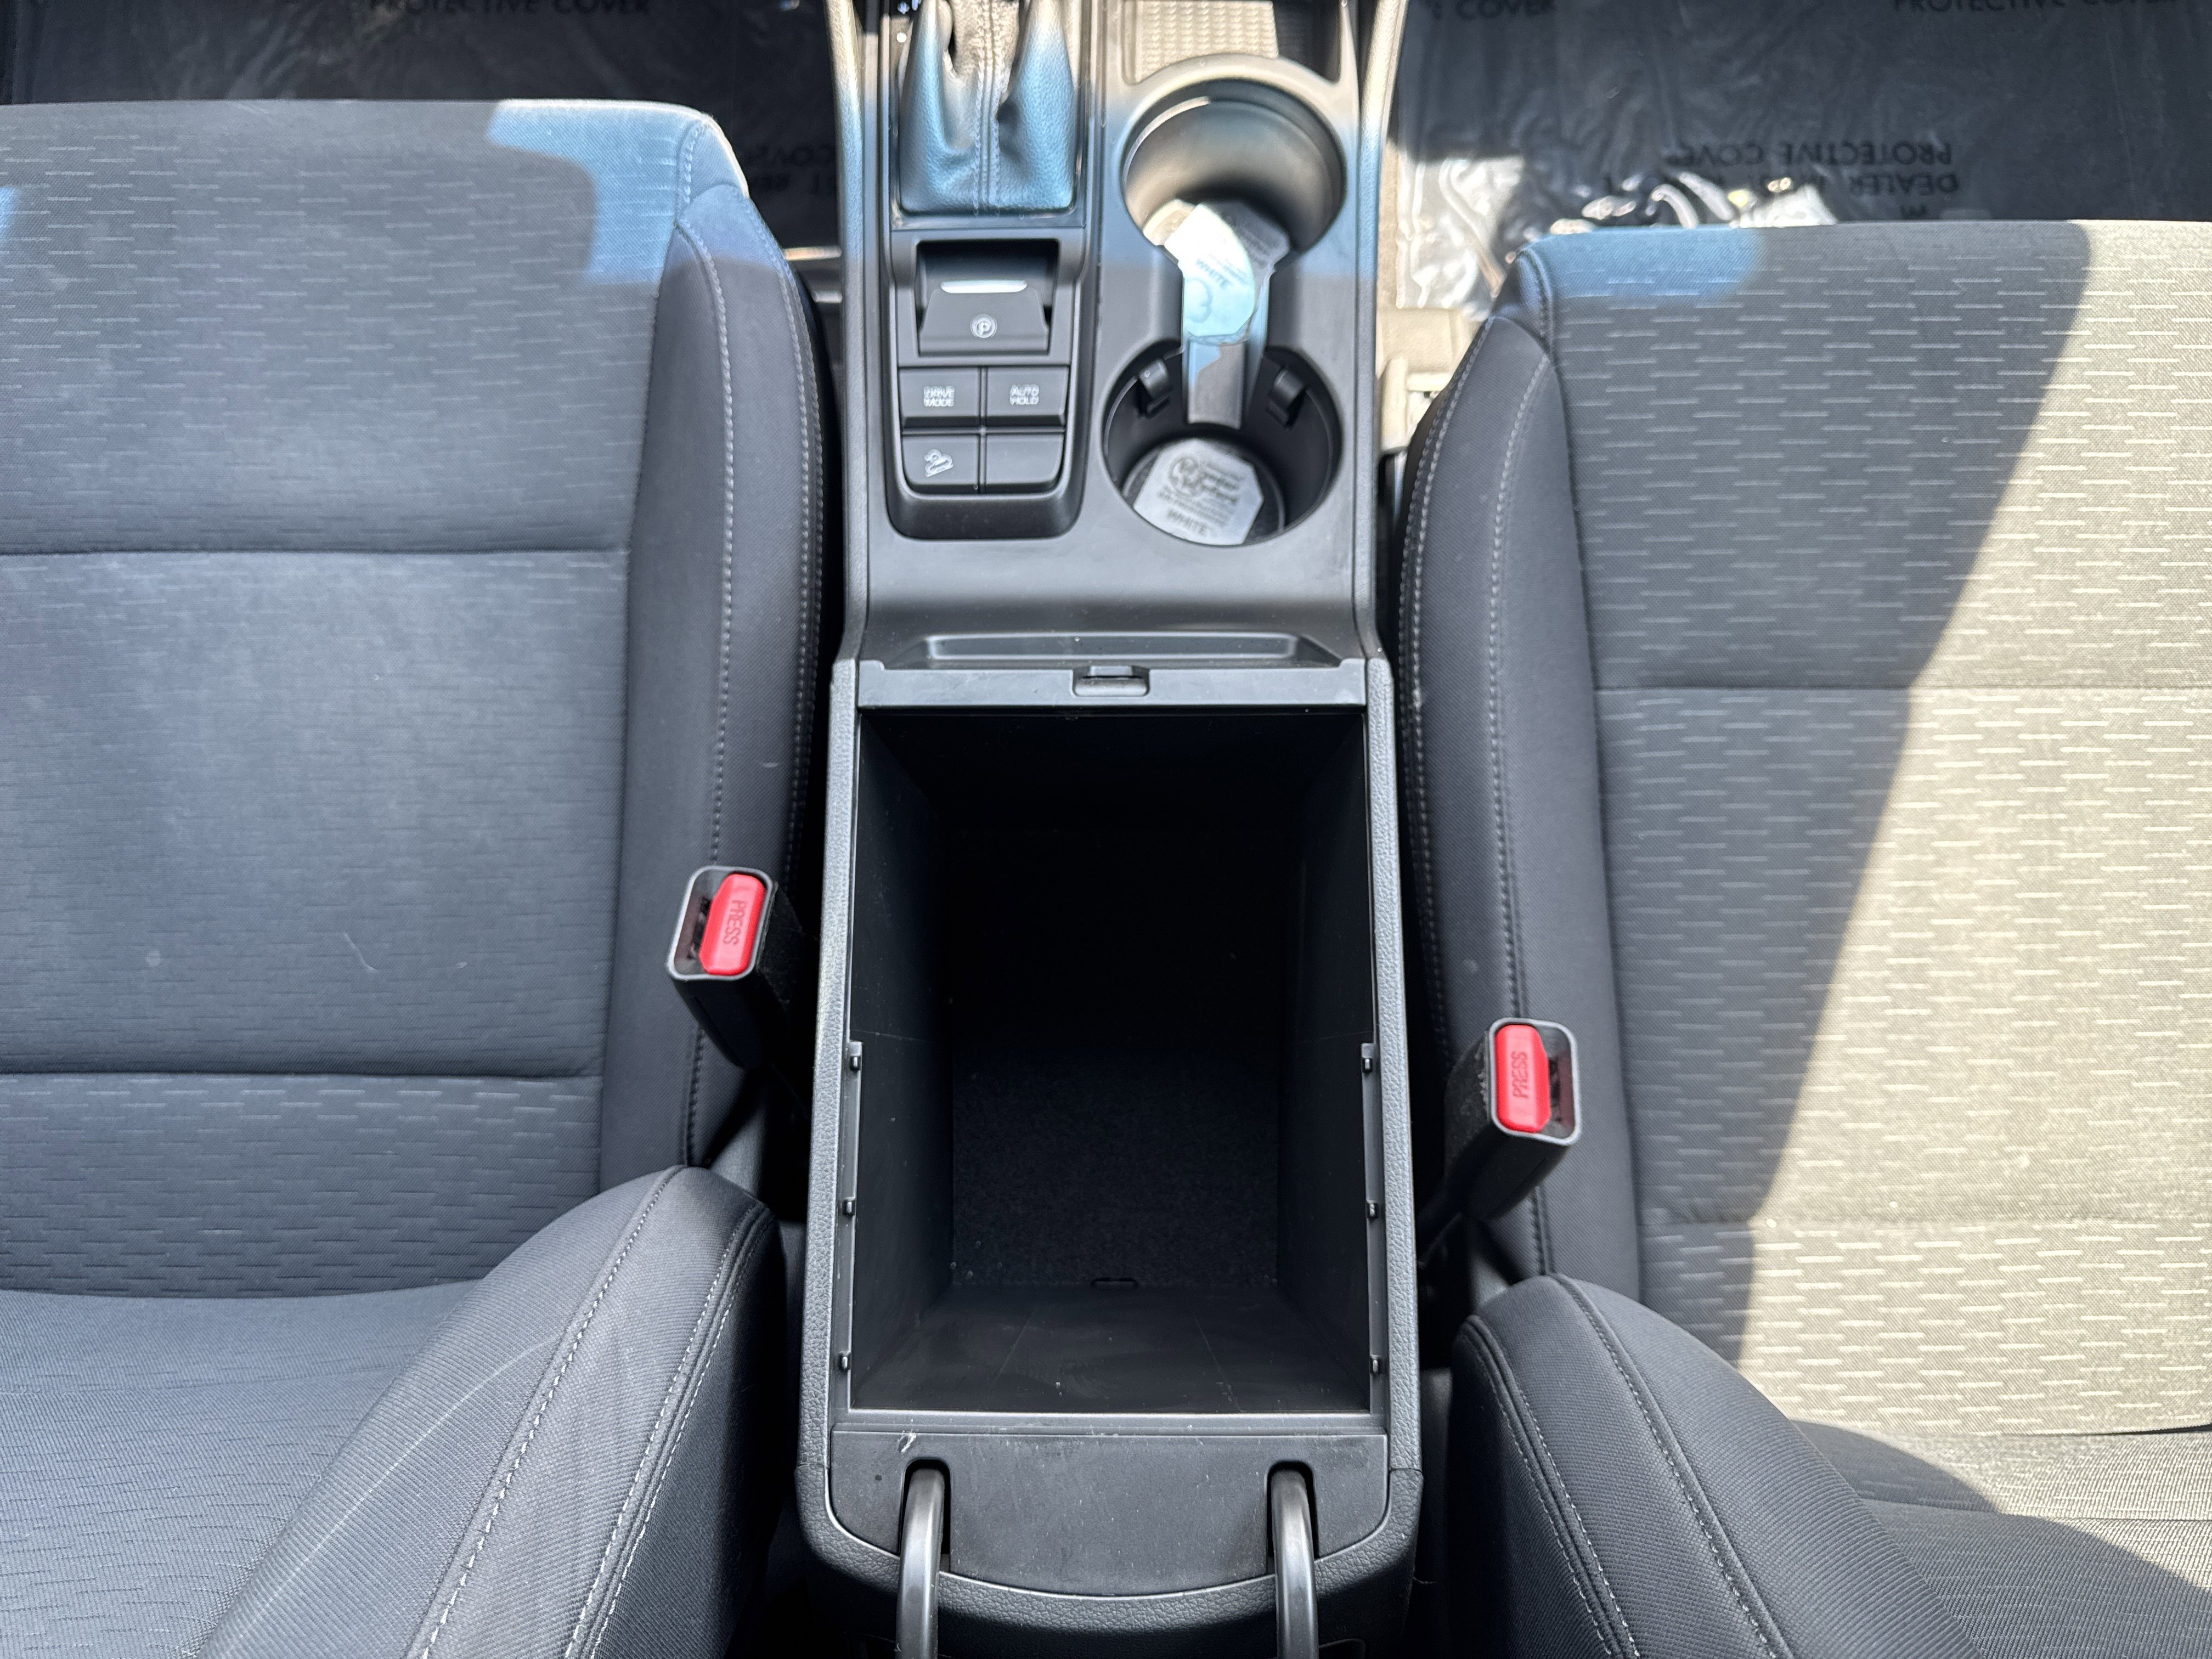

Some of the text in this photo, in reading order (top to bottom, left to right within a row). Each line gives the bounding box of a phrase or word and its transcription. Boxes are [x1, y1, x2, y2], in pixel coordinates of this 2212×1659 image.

[369, 0, 541, 14] OTECTIVE
[1780, 141, 1953, 165] PROTECTIVE
[1849, 173, 1960, 196] DEALER
[1196, 258, 1231, 289] WHITE
[923, 386, 955, 398] DRIVE
[923, 397, 955, 407] MODE
[1009, 385, 1039, 396] AUTO
[1009, 396, 1039, 405] HOLD
[1167, 508, 1207, 535] WHITE
[724, 900, 747, 946] PRESS
[1511, 1051, 1529, 1099] PRESS
